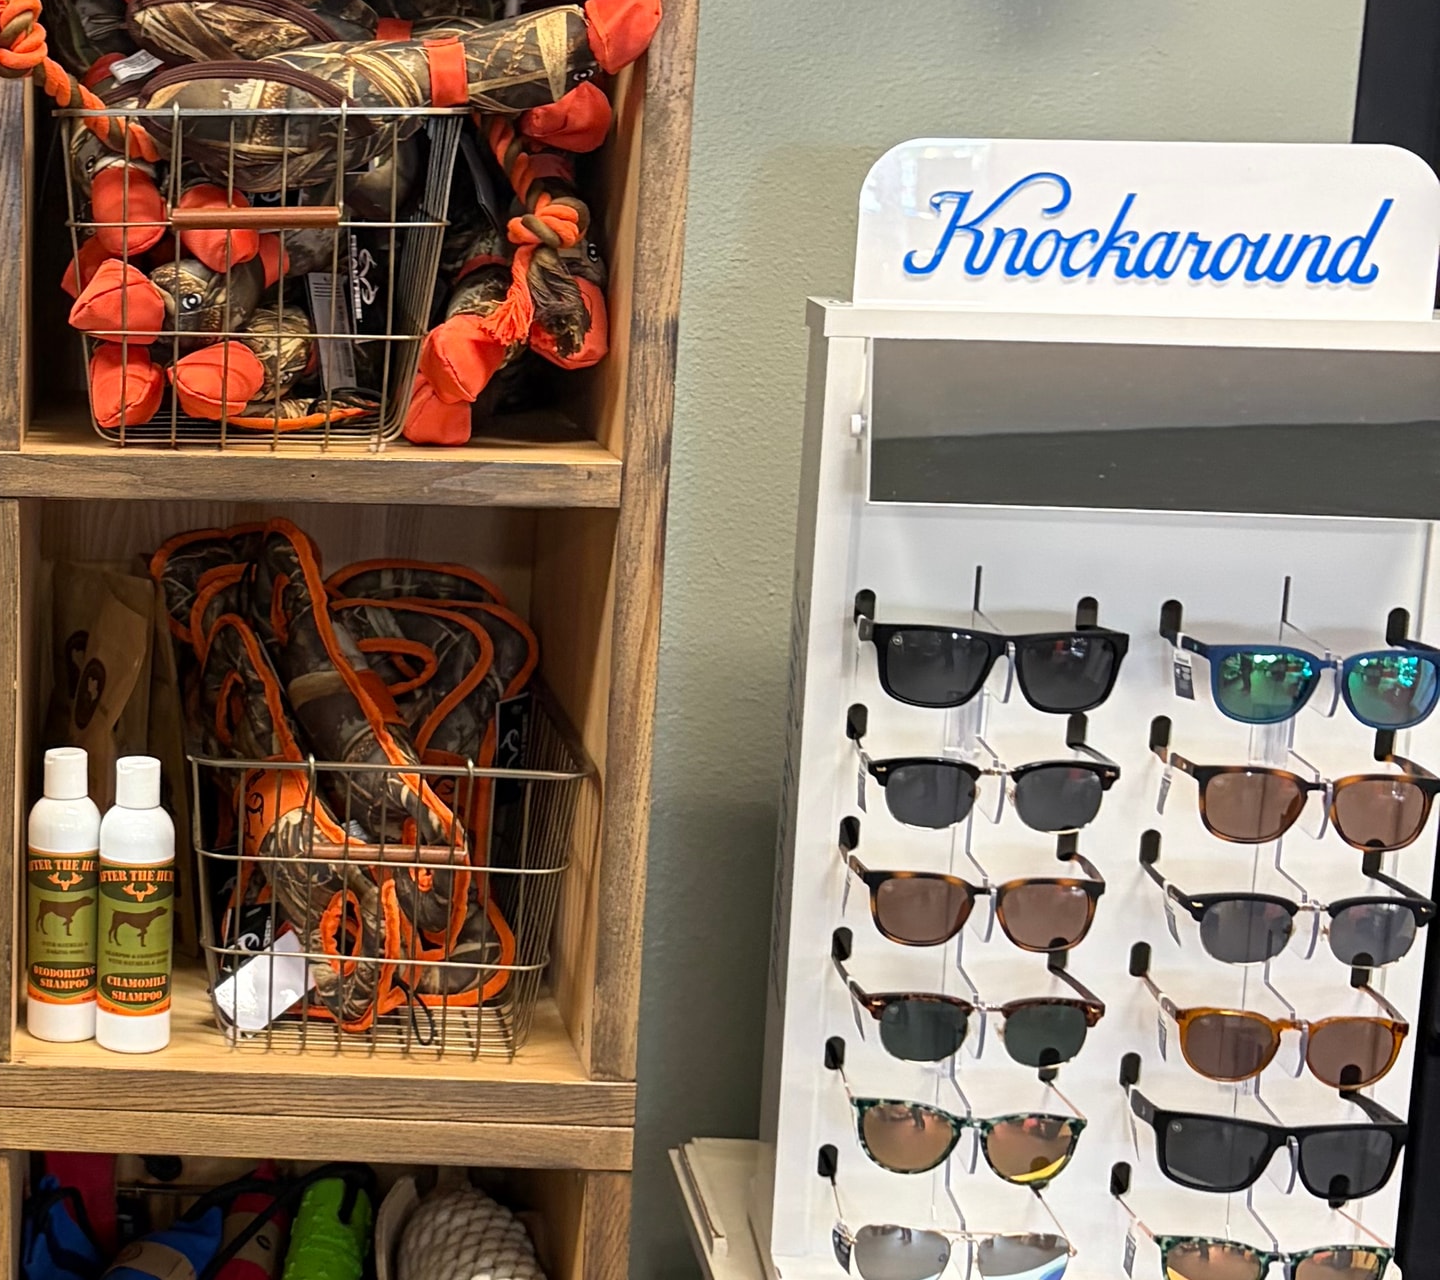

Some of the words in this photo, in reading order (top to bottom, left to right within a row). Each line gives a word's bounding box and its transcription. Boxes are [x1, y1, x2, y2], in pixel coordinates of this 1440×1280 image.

[902, 171, 1395, 285] Knockaround
[54, 859, 80, 871] THE
[129, 870, 155, 882] THE
[33, 964, 96, 979] DEODORIZING
[39, 978, 89, 990] SHAMPOO
[106, 974, 167, 988] CHAMOMILE
[111, 990, 163, 1002] SHAMPOO
